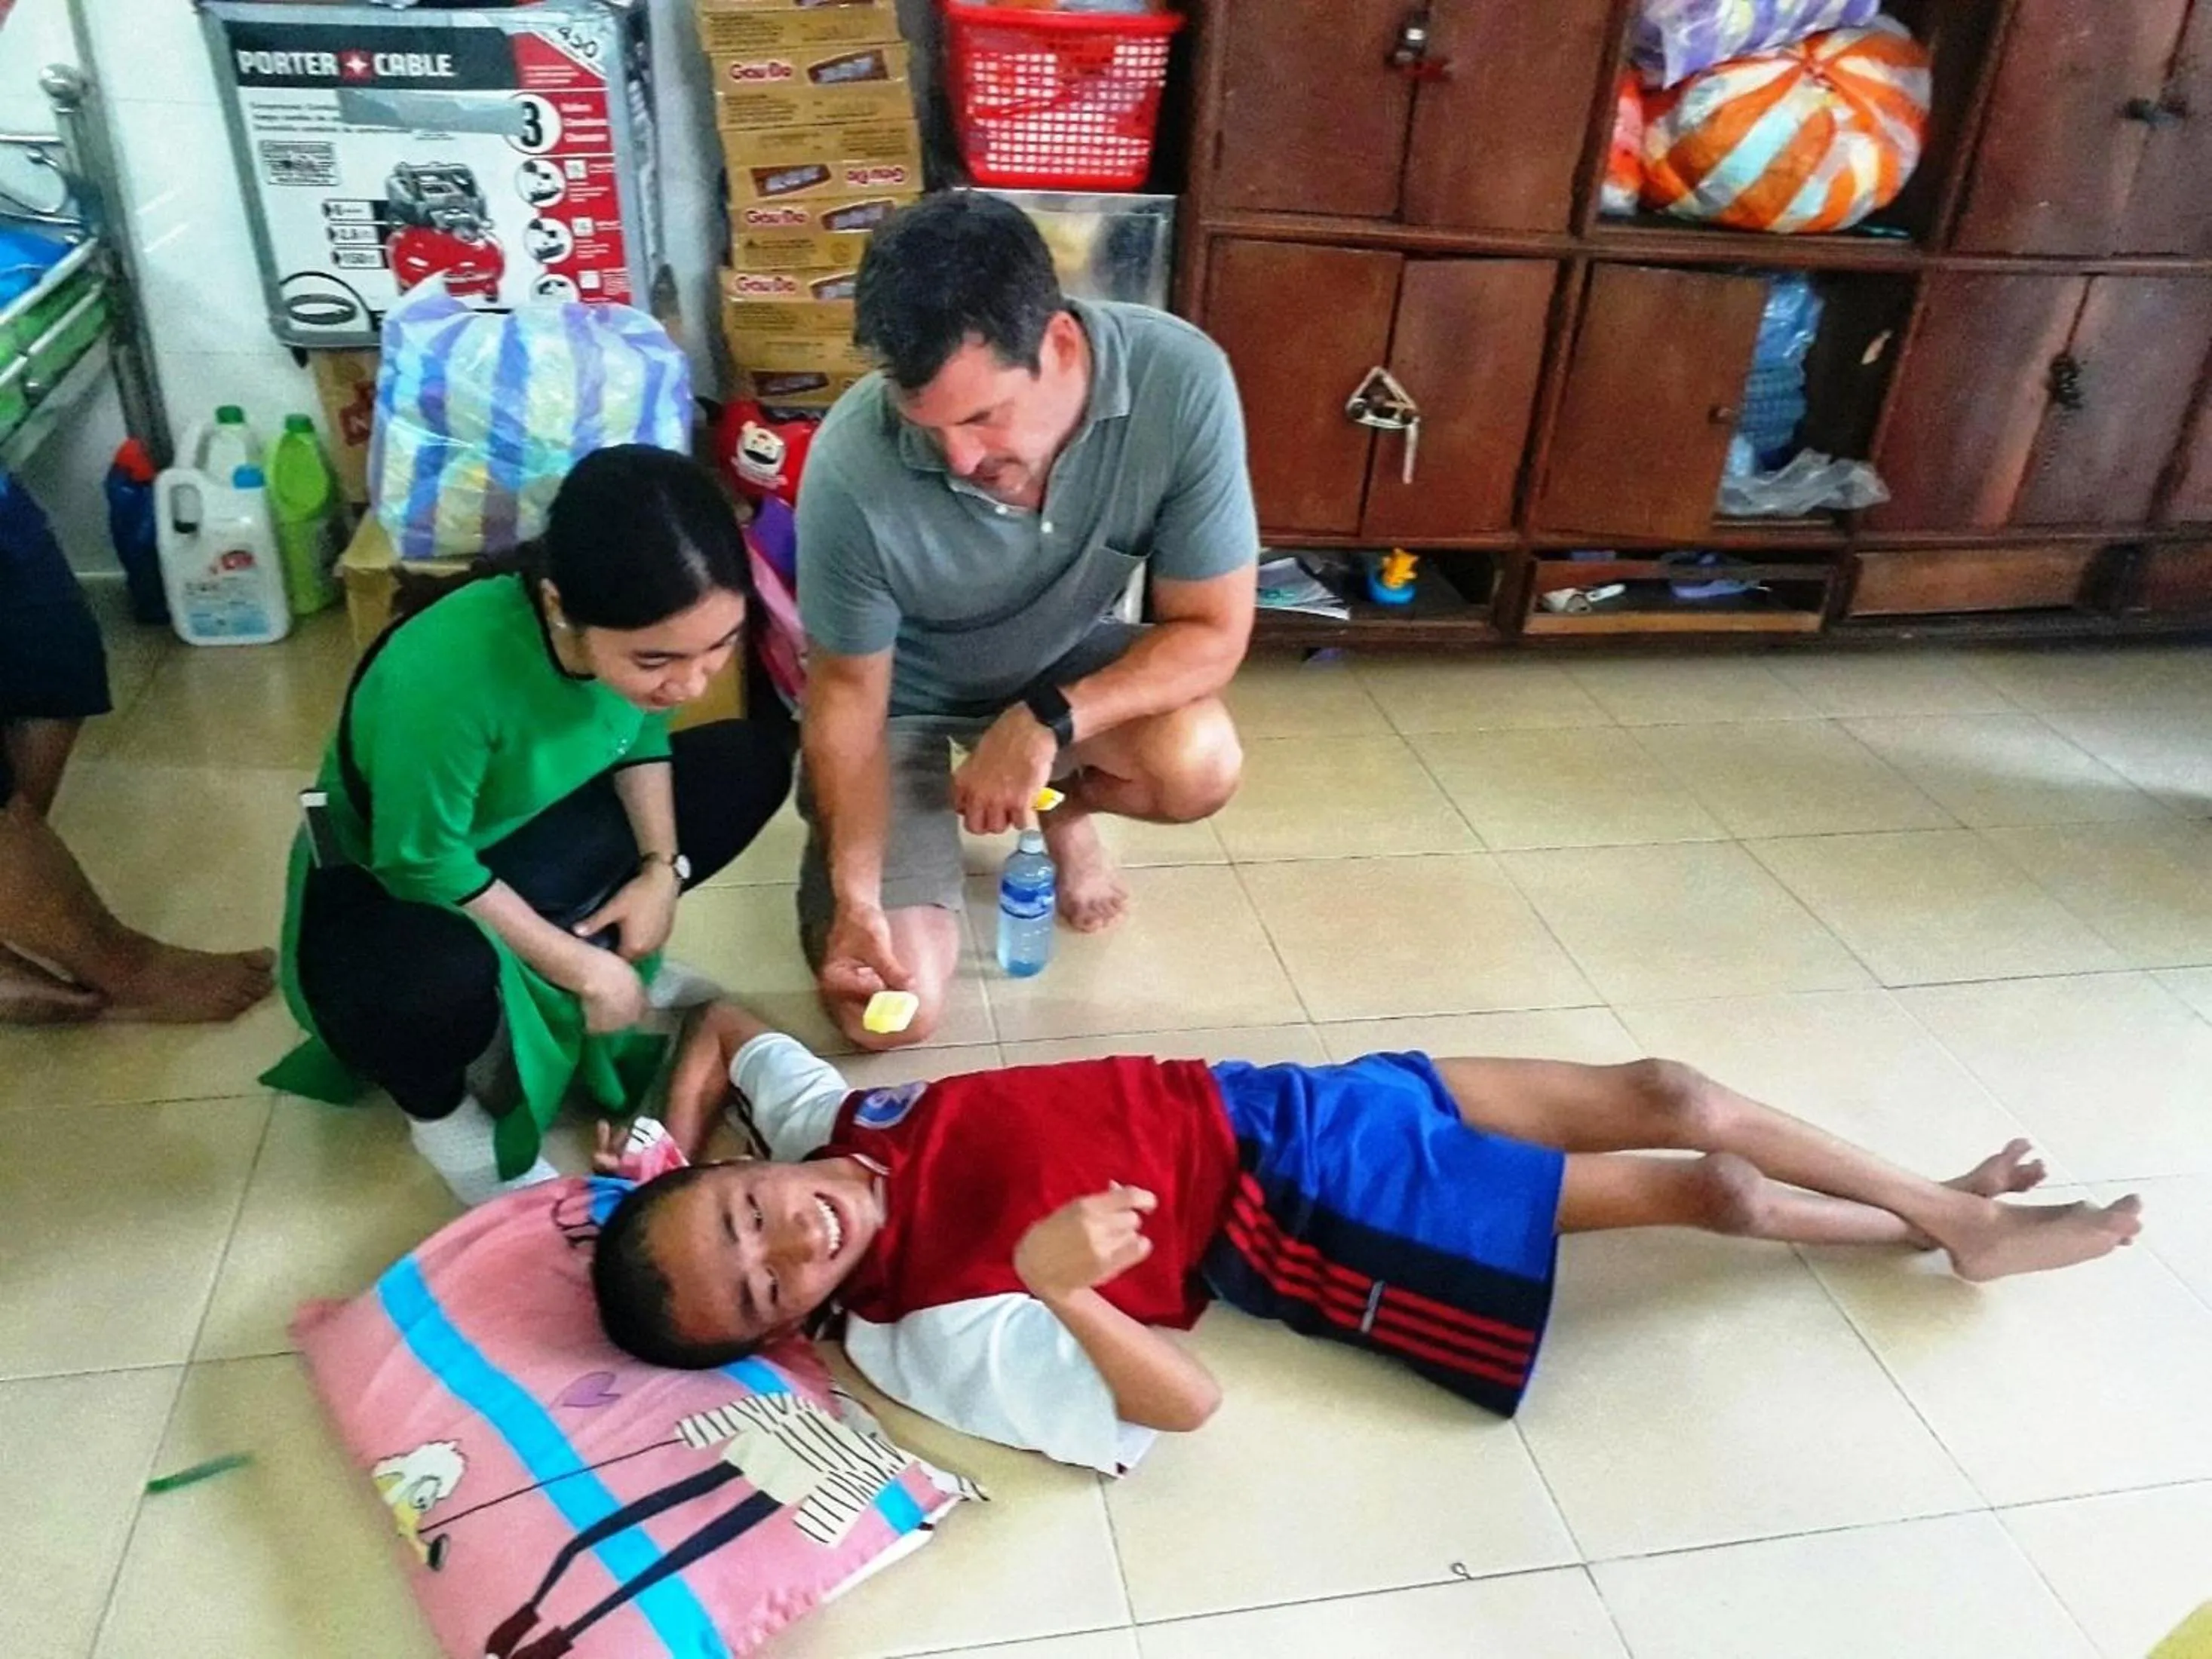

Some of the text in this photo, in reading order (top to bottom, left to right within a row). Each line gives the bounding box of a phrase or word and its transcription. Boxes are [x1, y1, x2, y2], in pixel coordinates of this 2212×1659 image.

[238, 50, 455, 76] PORTER CABLE
[520, 101, 542, 147] 3
